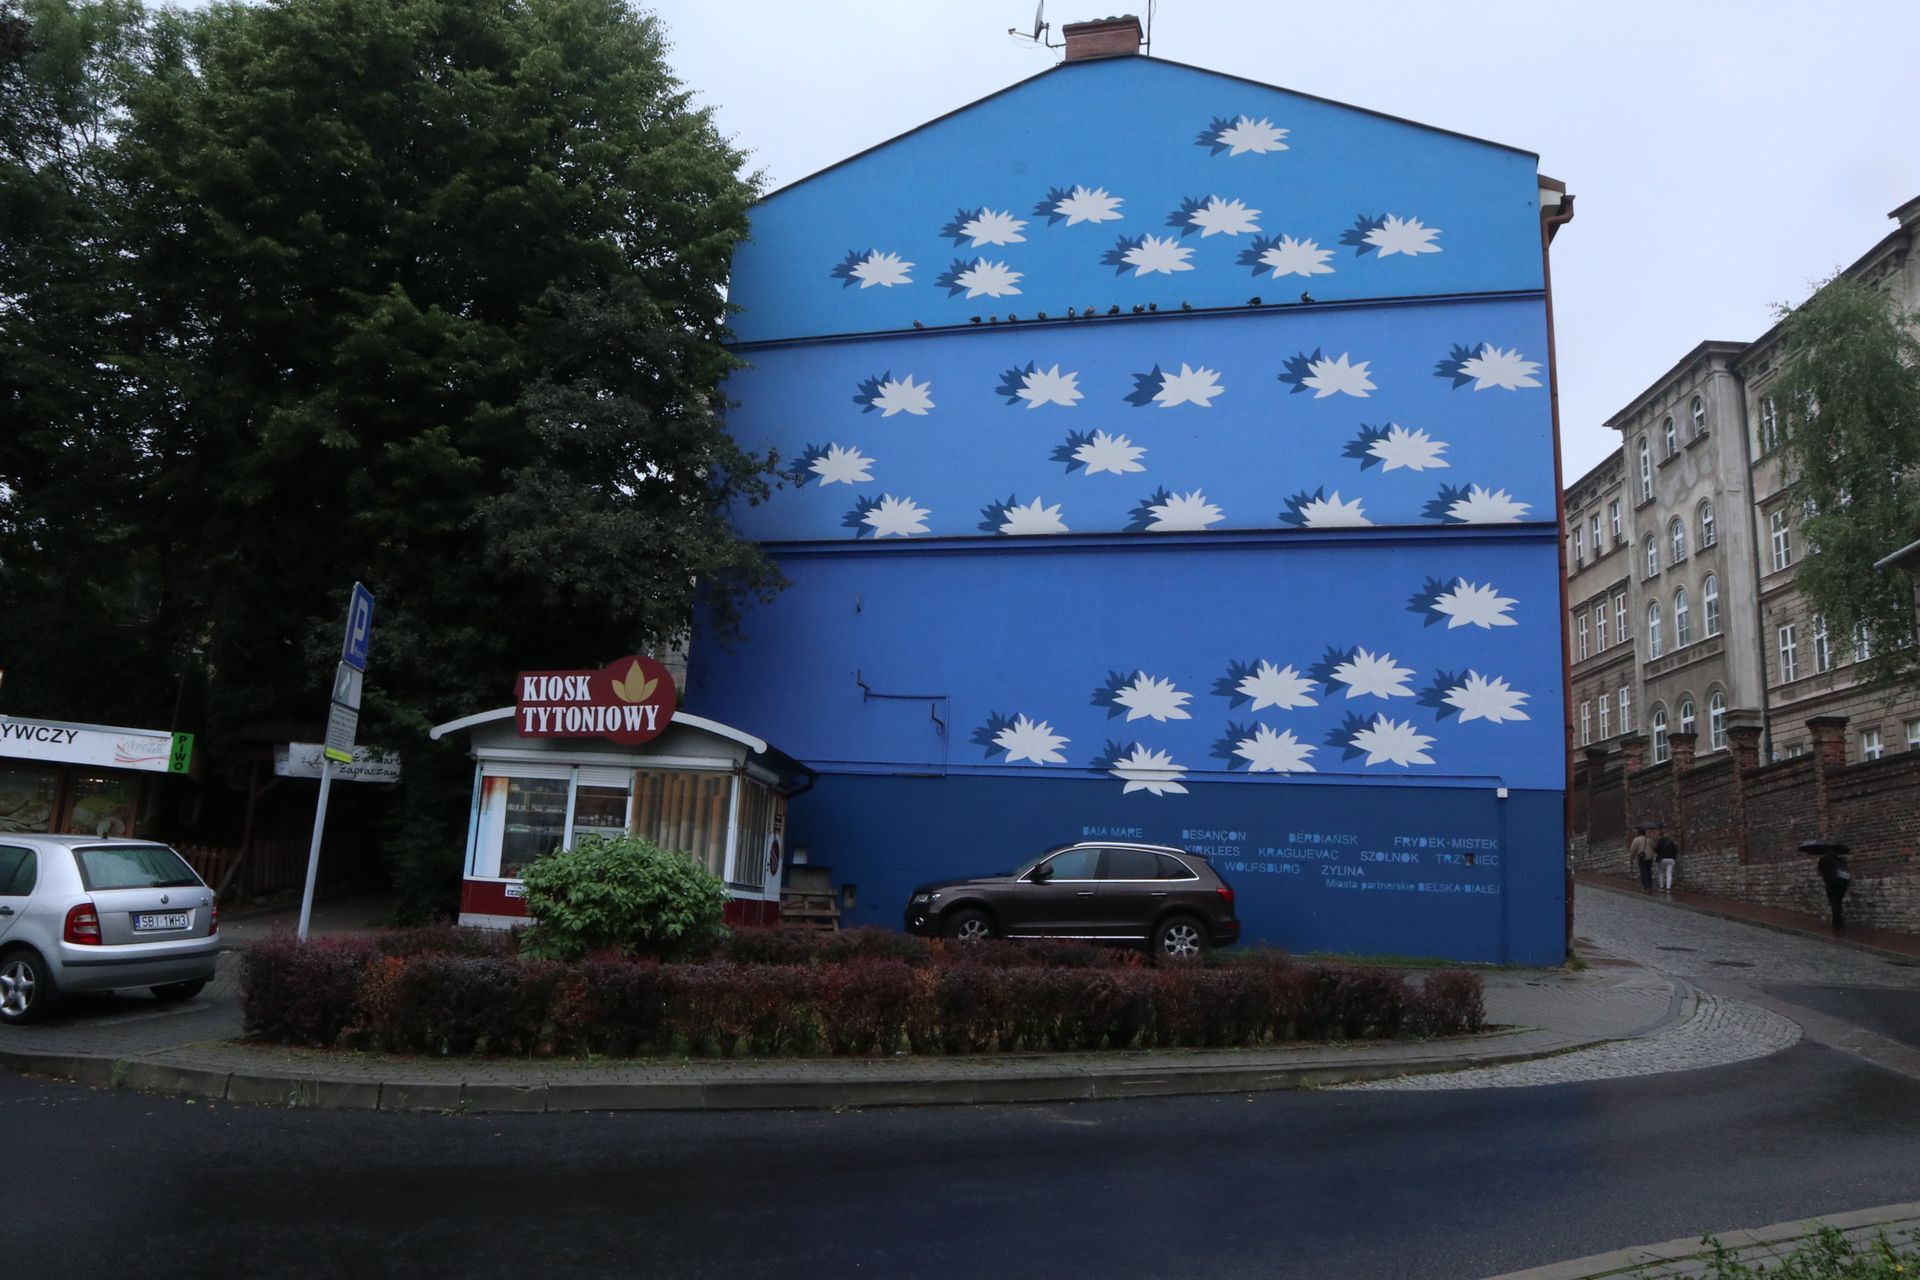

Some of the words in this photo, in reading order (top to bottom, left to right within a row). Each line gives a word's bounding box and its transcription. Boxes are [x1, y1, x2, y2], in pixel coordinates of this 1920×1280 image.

[351, 595, 369, 655] P
[522, 674, 592, 701] KIOSK
[522, 704, 660, 733] TYTONIOWY
[0, 723, 79, 744] YWCZY
[174, 735, 188, 771] PIWO
[1082, 826, 1107, 836] BAIA
[1110, 826, 1144, 838] MARE
[1182, 829, 1246, 842] BESANÇON
[1184, 844, 1240, 856] KIRKLEES
[1258, 847, 1339, 860] KRAGUJEVAC
[1360, 851, 1420, 863] SZOLNOK
[1225, 861, 1300, 874] WOLFSBURG
[1325, 878, 1358, 889] Miasta
[1361, 881, 1415, 892] partnerskie
[141, 916, 159, 928] SBI
[164, 915, 186, 927] 1WH3
